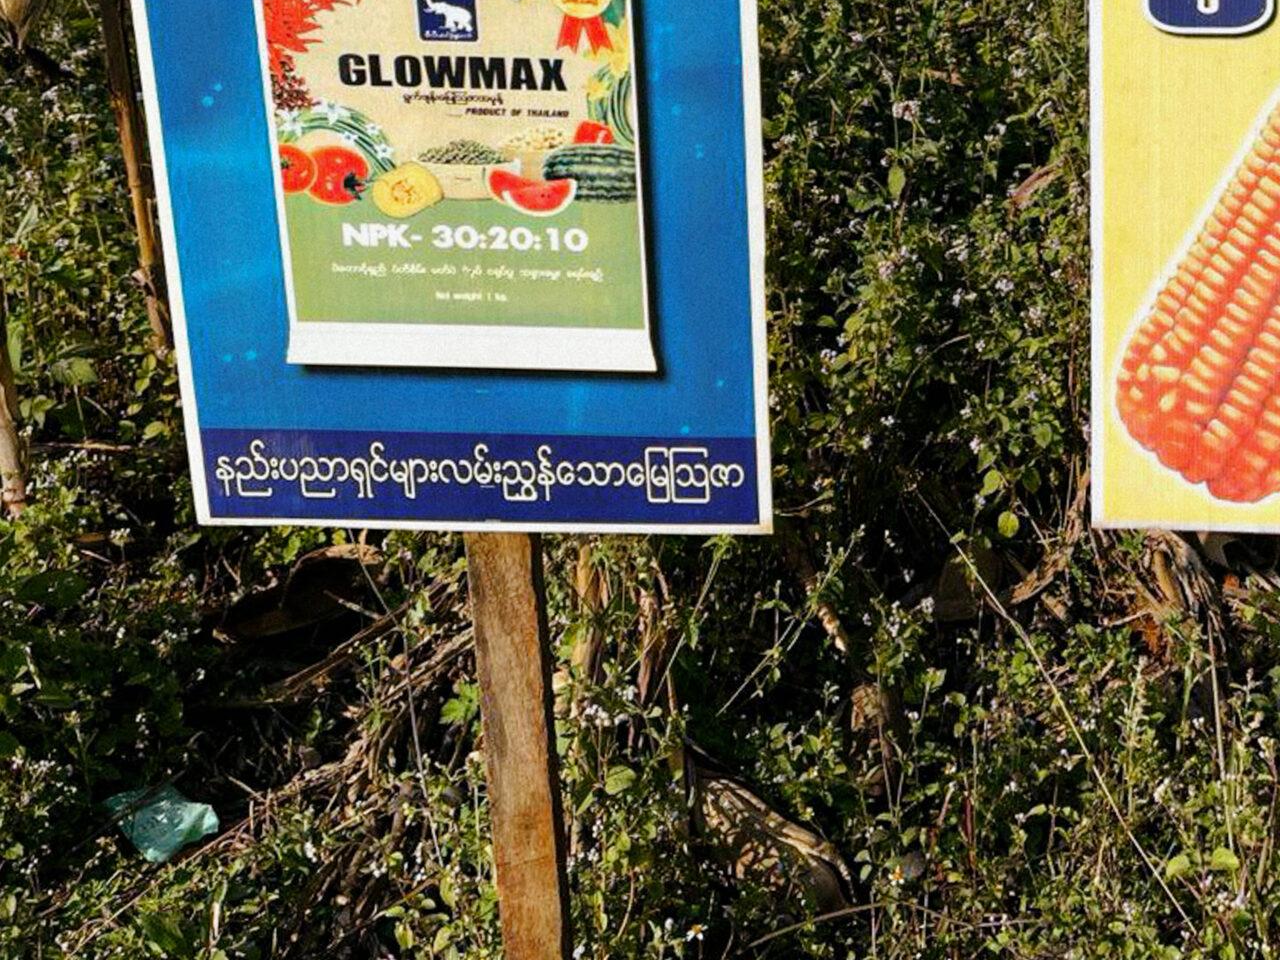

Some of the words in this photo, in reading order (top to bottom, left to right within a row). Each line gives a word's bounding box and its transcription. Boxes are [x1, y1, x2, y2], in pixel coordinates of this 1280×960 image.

[338, 53, 568, 91] GLOWMAX
[465, 107, 506, 117] PRODUCT
[510, 109, 521, 117] OF
[526, 109, 569, 119] THAILAND
[431, 224, 590, 253] 30:20:10
